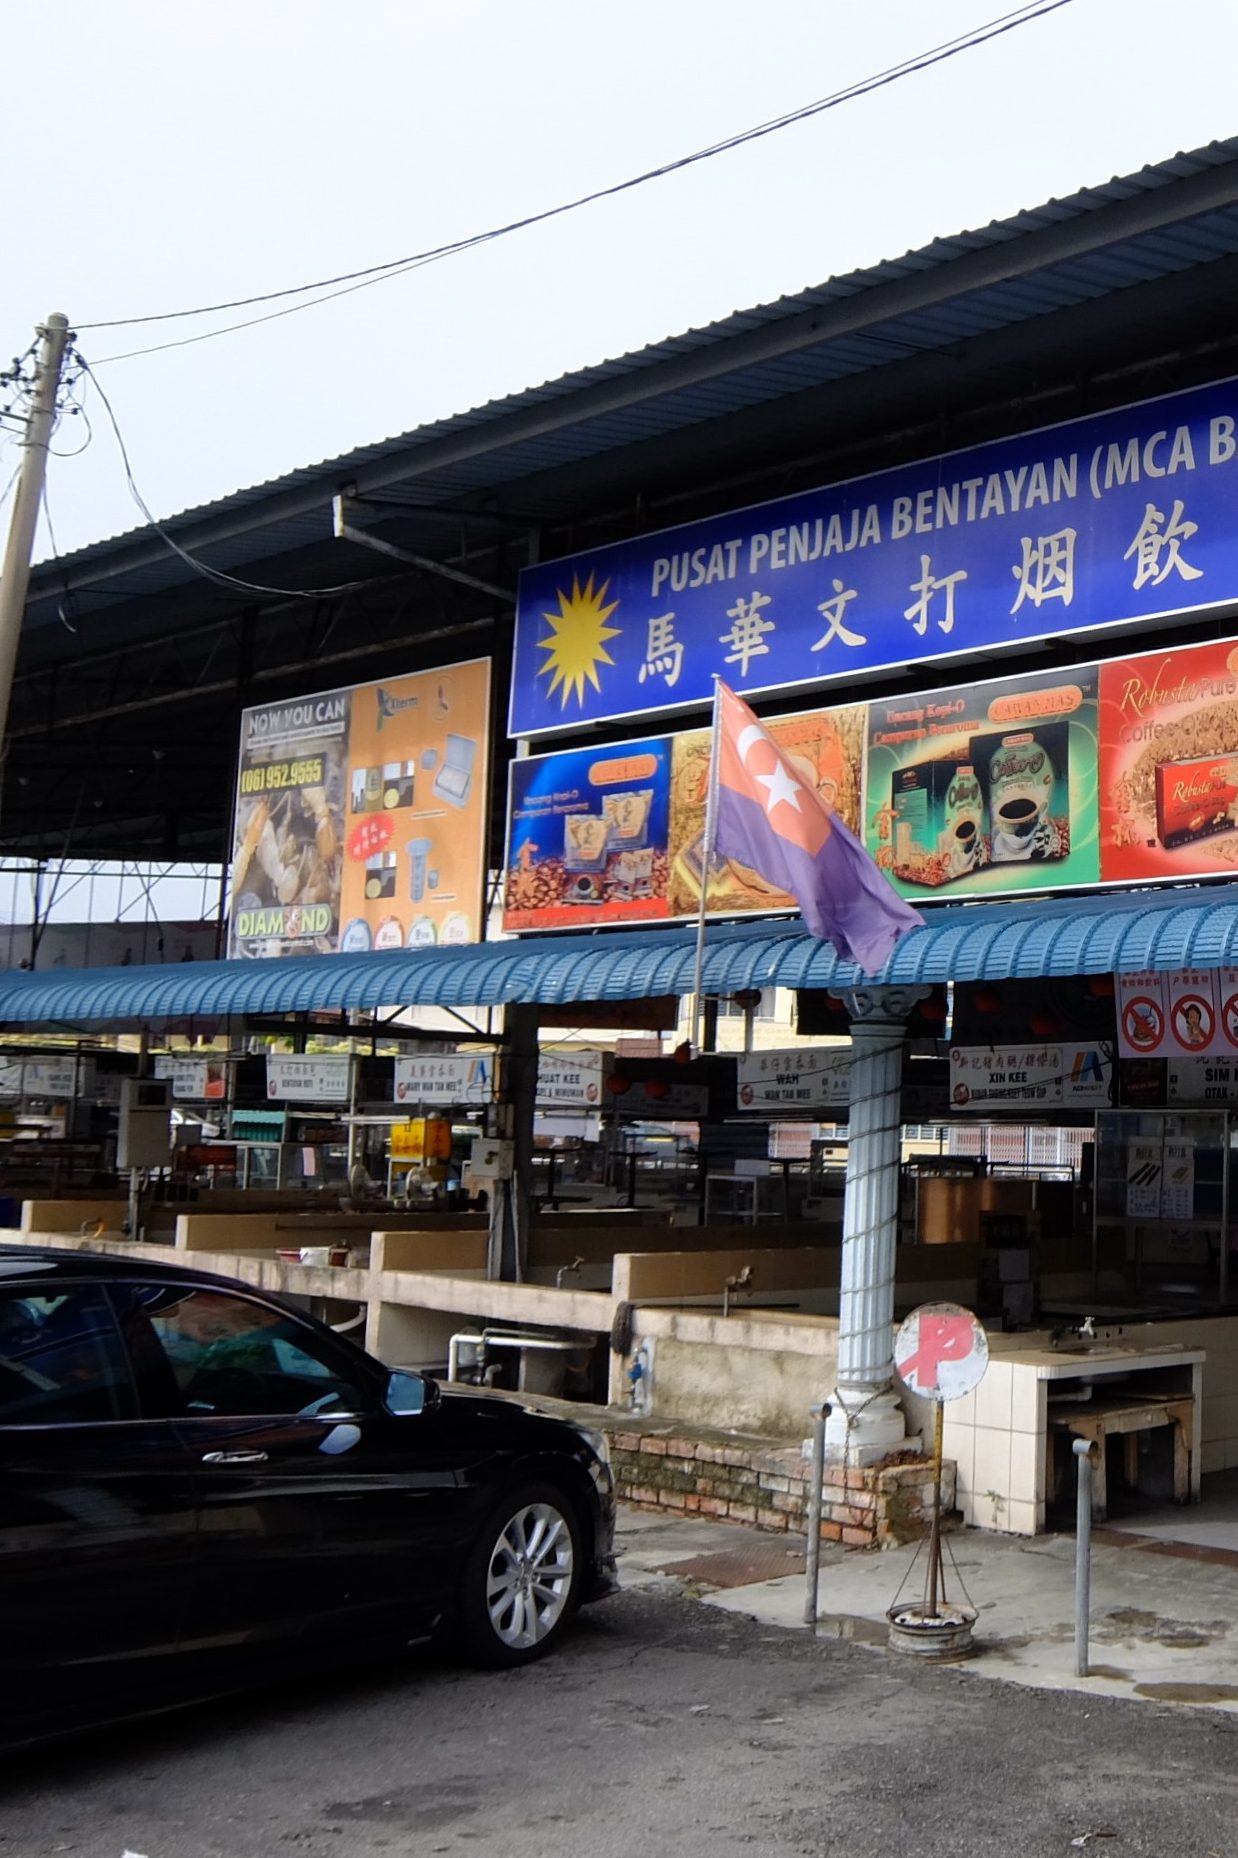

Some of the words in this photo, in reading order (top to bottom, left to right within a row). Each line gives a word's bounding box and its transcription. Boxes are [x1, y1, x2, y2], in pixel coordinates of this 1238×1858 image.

[652, 538, 743, 597] PUSAT
[749, 505, 881, 574] PENJAJA
[890, 453, 1077, 540] BENTAYAN
[1089, 438, 1195, 499] (MCA
[1120, 658, 1200, 718] Robusta
[1200, 677, 1237, 699] Pure
[249, 710, 281, 735] NOW
[285, 705, 313, 727] YOU
[316, 698, 345, 721] CAN
[239, 908, 329, 936] DIAMND
[563, 1074, 580, 1084] KEE
[989, 1072, 1005, 1083] XIN
[1008, 1072, 1027, 1083] KEE
[1205, 1068, 1229, 1082] SIM
[1205, 1087, 1228, 1099] OTAK
